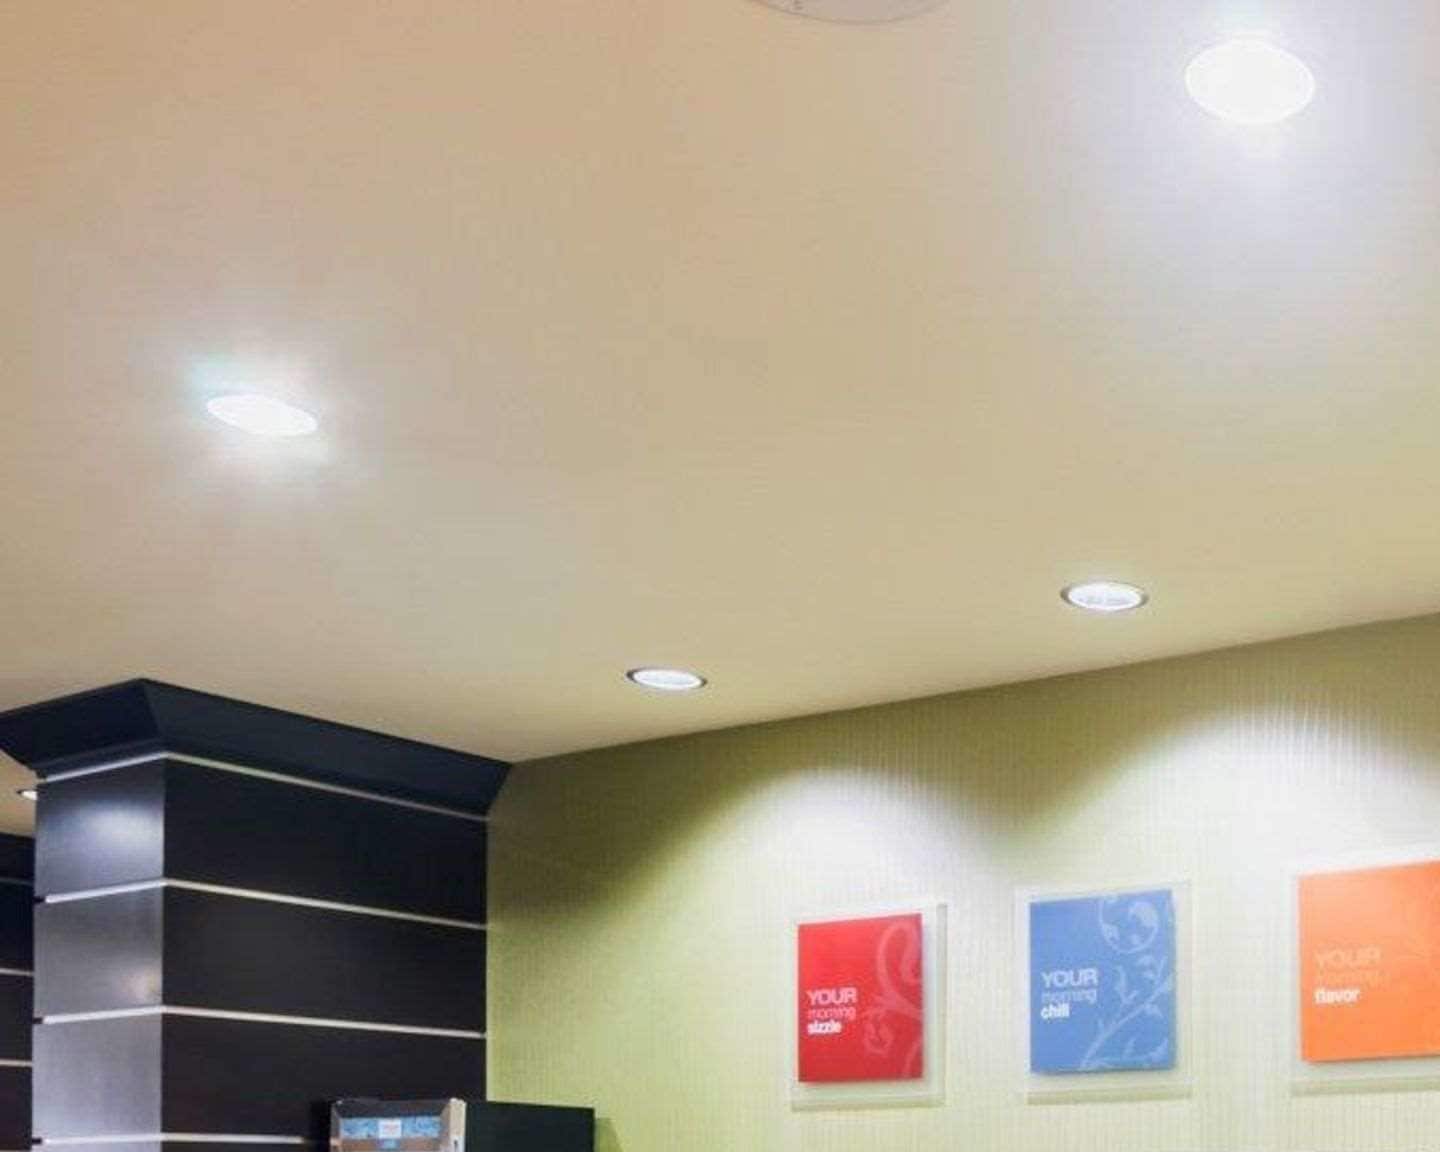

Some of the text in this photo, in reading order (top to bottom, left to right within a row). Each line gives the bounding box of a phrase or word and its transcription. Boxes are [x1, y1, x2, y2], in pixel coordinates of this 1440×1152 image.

[1041, 968, 1098, 988] YOUR
[805, 987, 857, 1006] YOUR
[1040, 1002, 1070, 1019] chill
